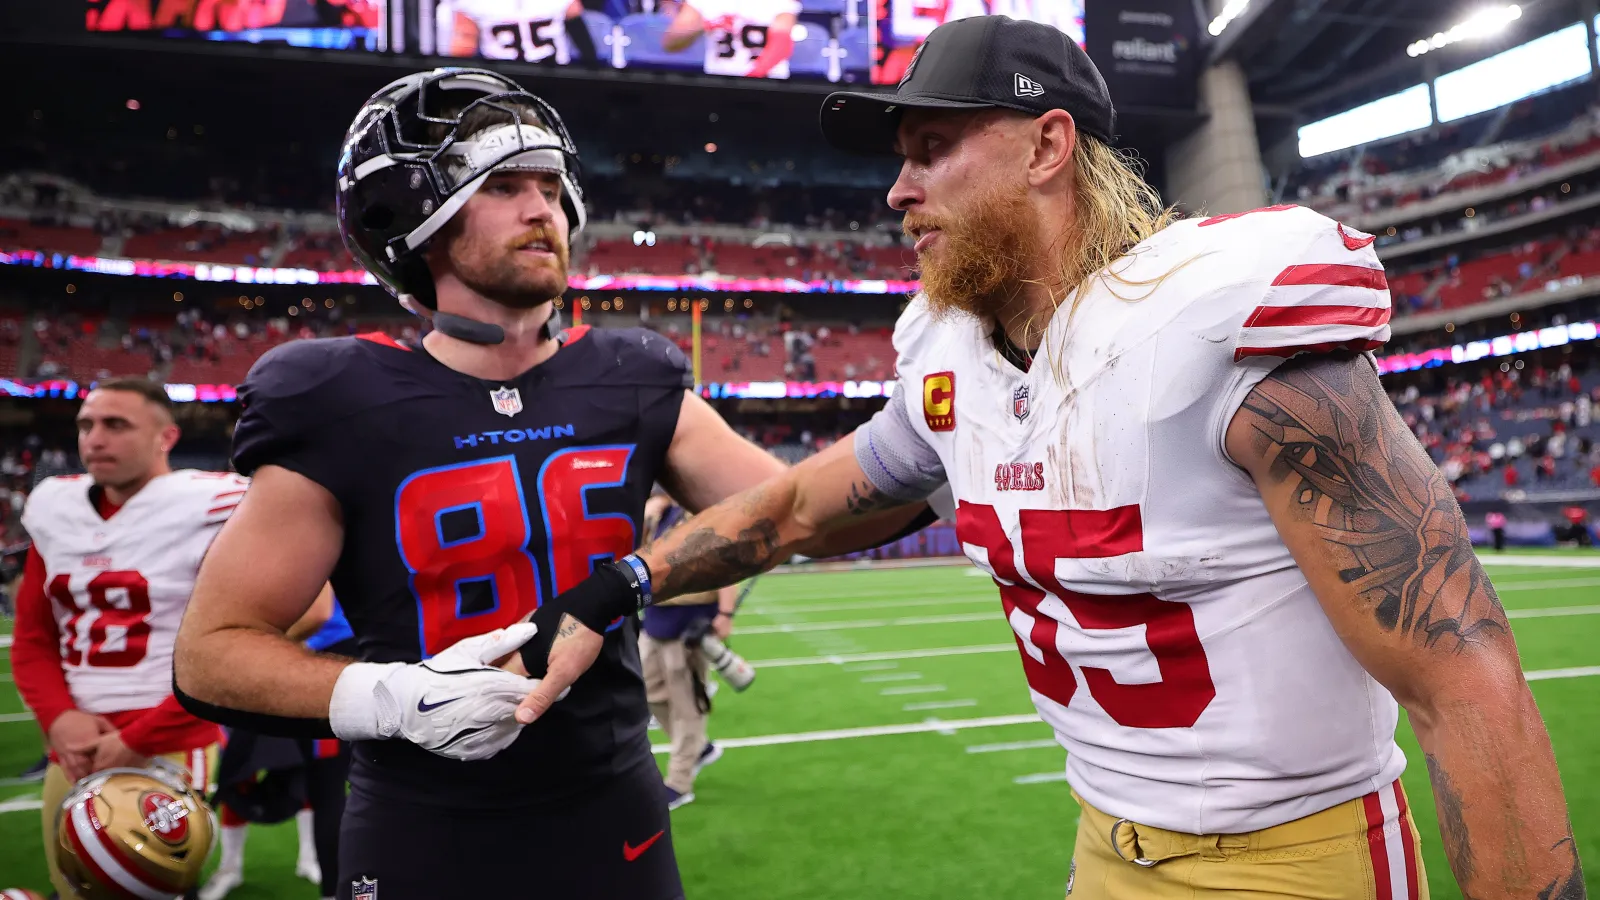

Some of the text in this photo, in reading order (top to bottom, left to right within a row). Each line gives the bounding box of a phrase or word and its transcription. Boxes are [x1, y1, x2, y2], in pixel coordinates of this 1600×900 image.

[492, 21, 556, 60] 35
[1112, 37, 1176, 62] reliant
[498, 399, 518, 411] NFL
[924, 375, 951, 416] C
[1015, 400, 1027, 415] NFL
[994, 462, 1045, 491] 49ERS
[394, 443, 636, 661] 86
[49, 570, 152, 668] 18
[955, 498, 1217, 729] 85
